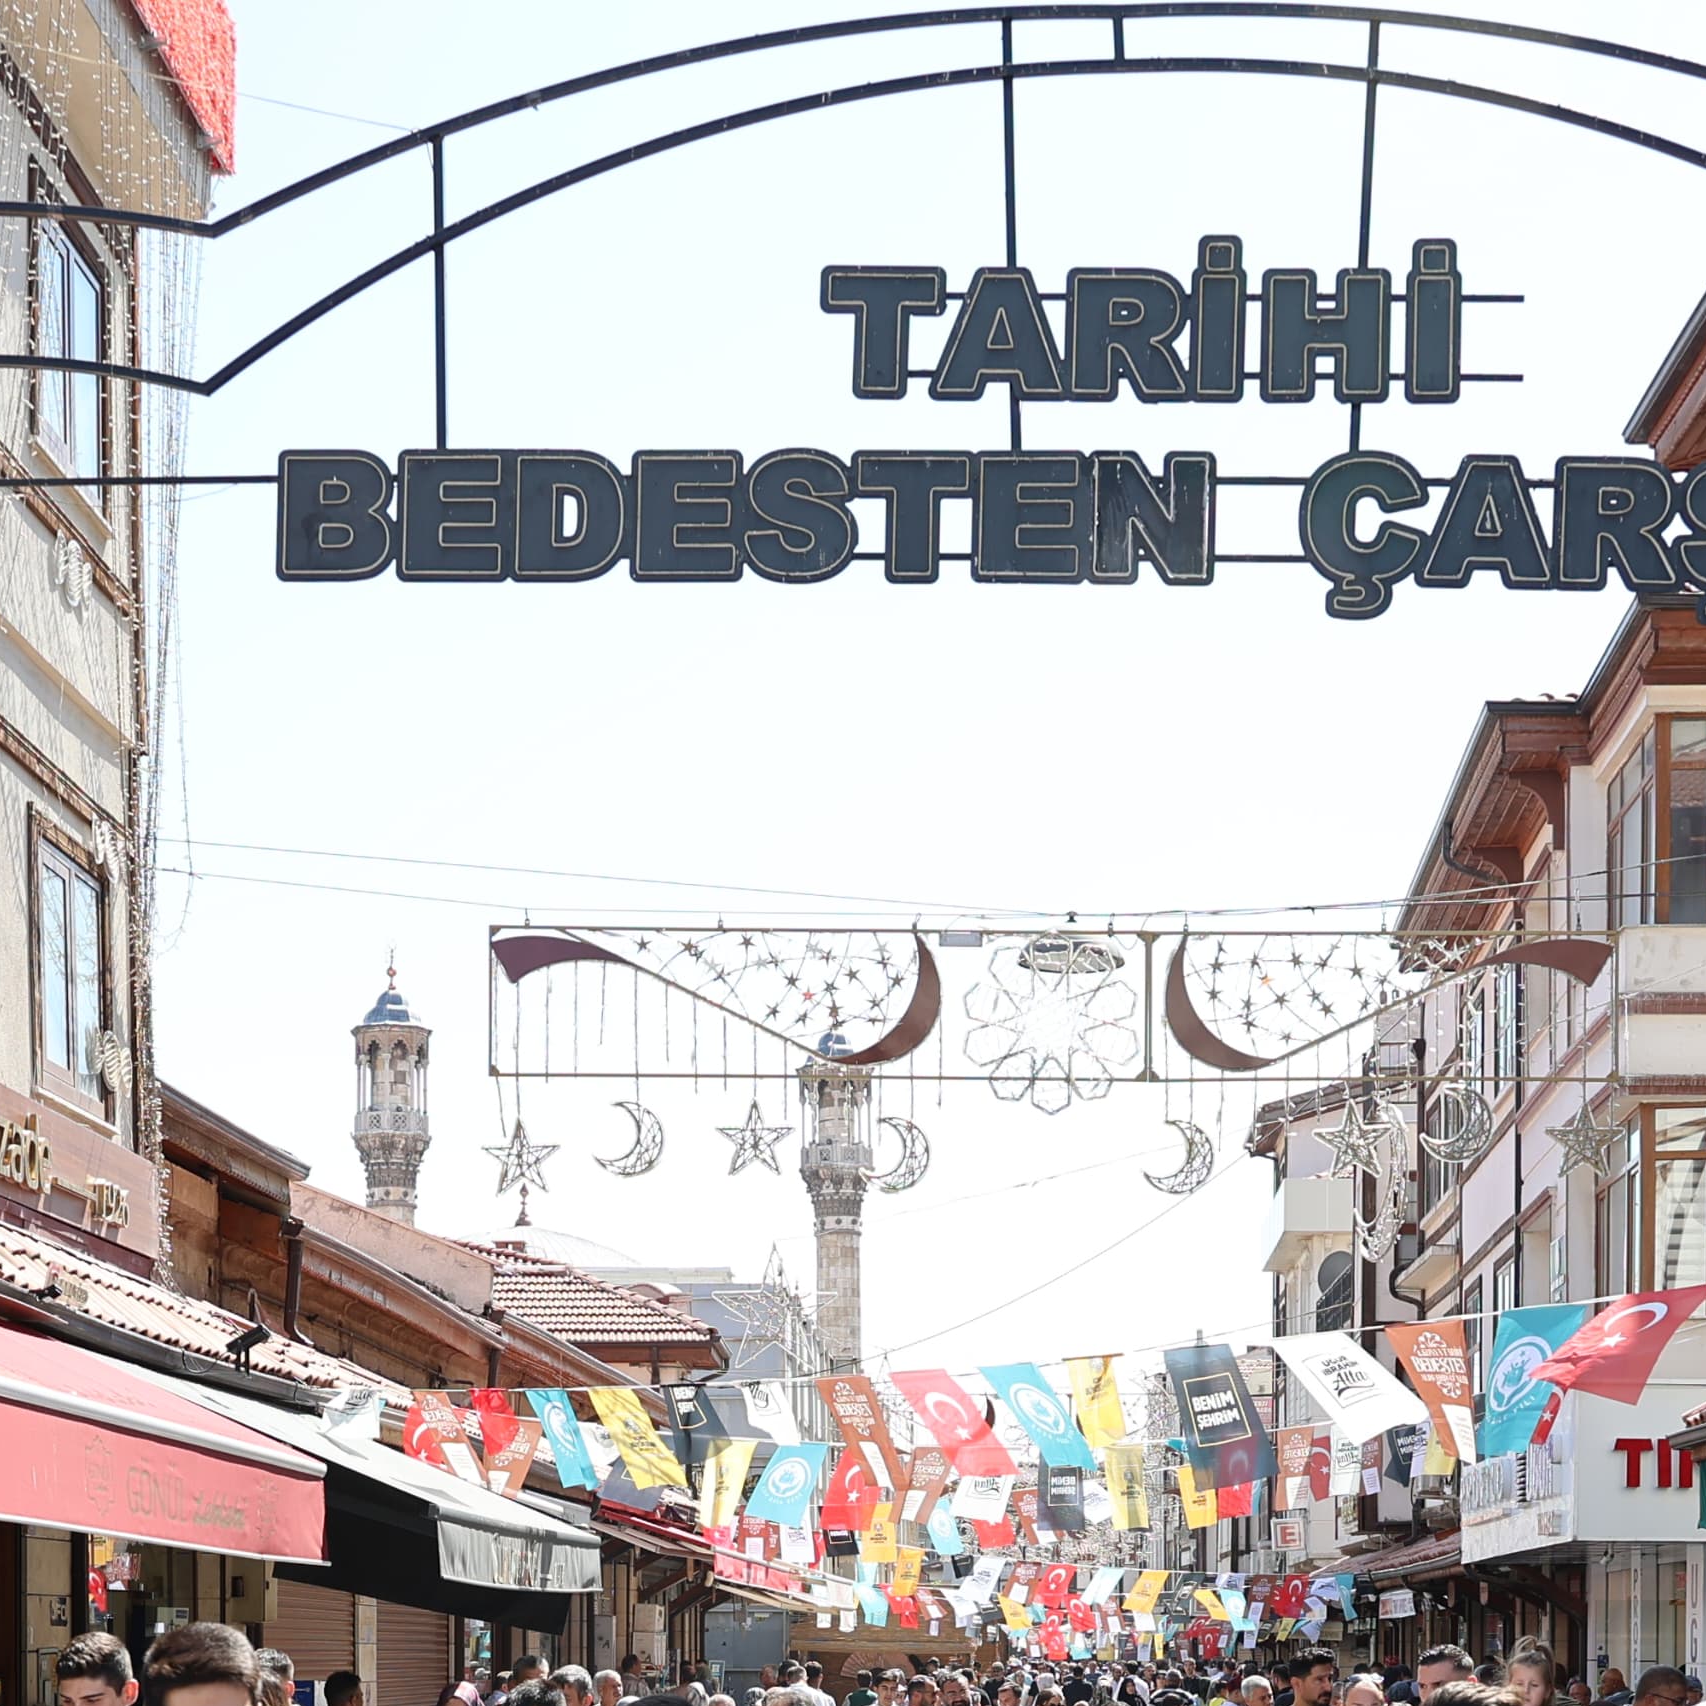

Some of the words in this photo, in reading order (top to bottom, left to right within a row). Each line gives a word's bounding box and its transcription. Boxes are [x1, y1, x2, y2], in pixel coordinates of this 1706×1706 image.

[819, 236, 1464, 403] TARİHİ
[278, 449, 1217, 586] BEDESTEN
[1192, 1390, 1236, 1410] BENİM
[1197, 1407, 1241, 1430] ŞEHRİM
[126, 1461, 190, 1522] GÖNÜL
